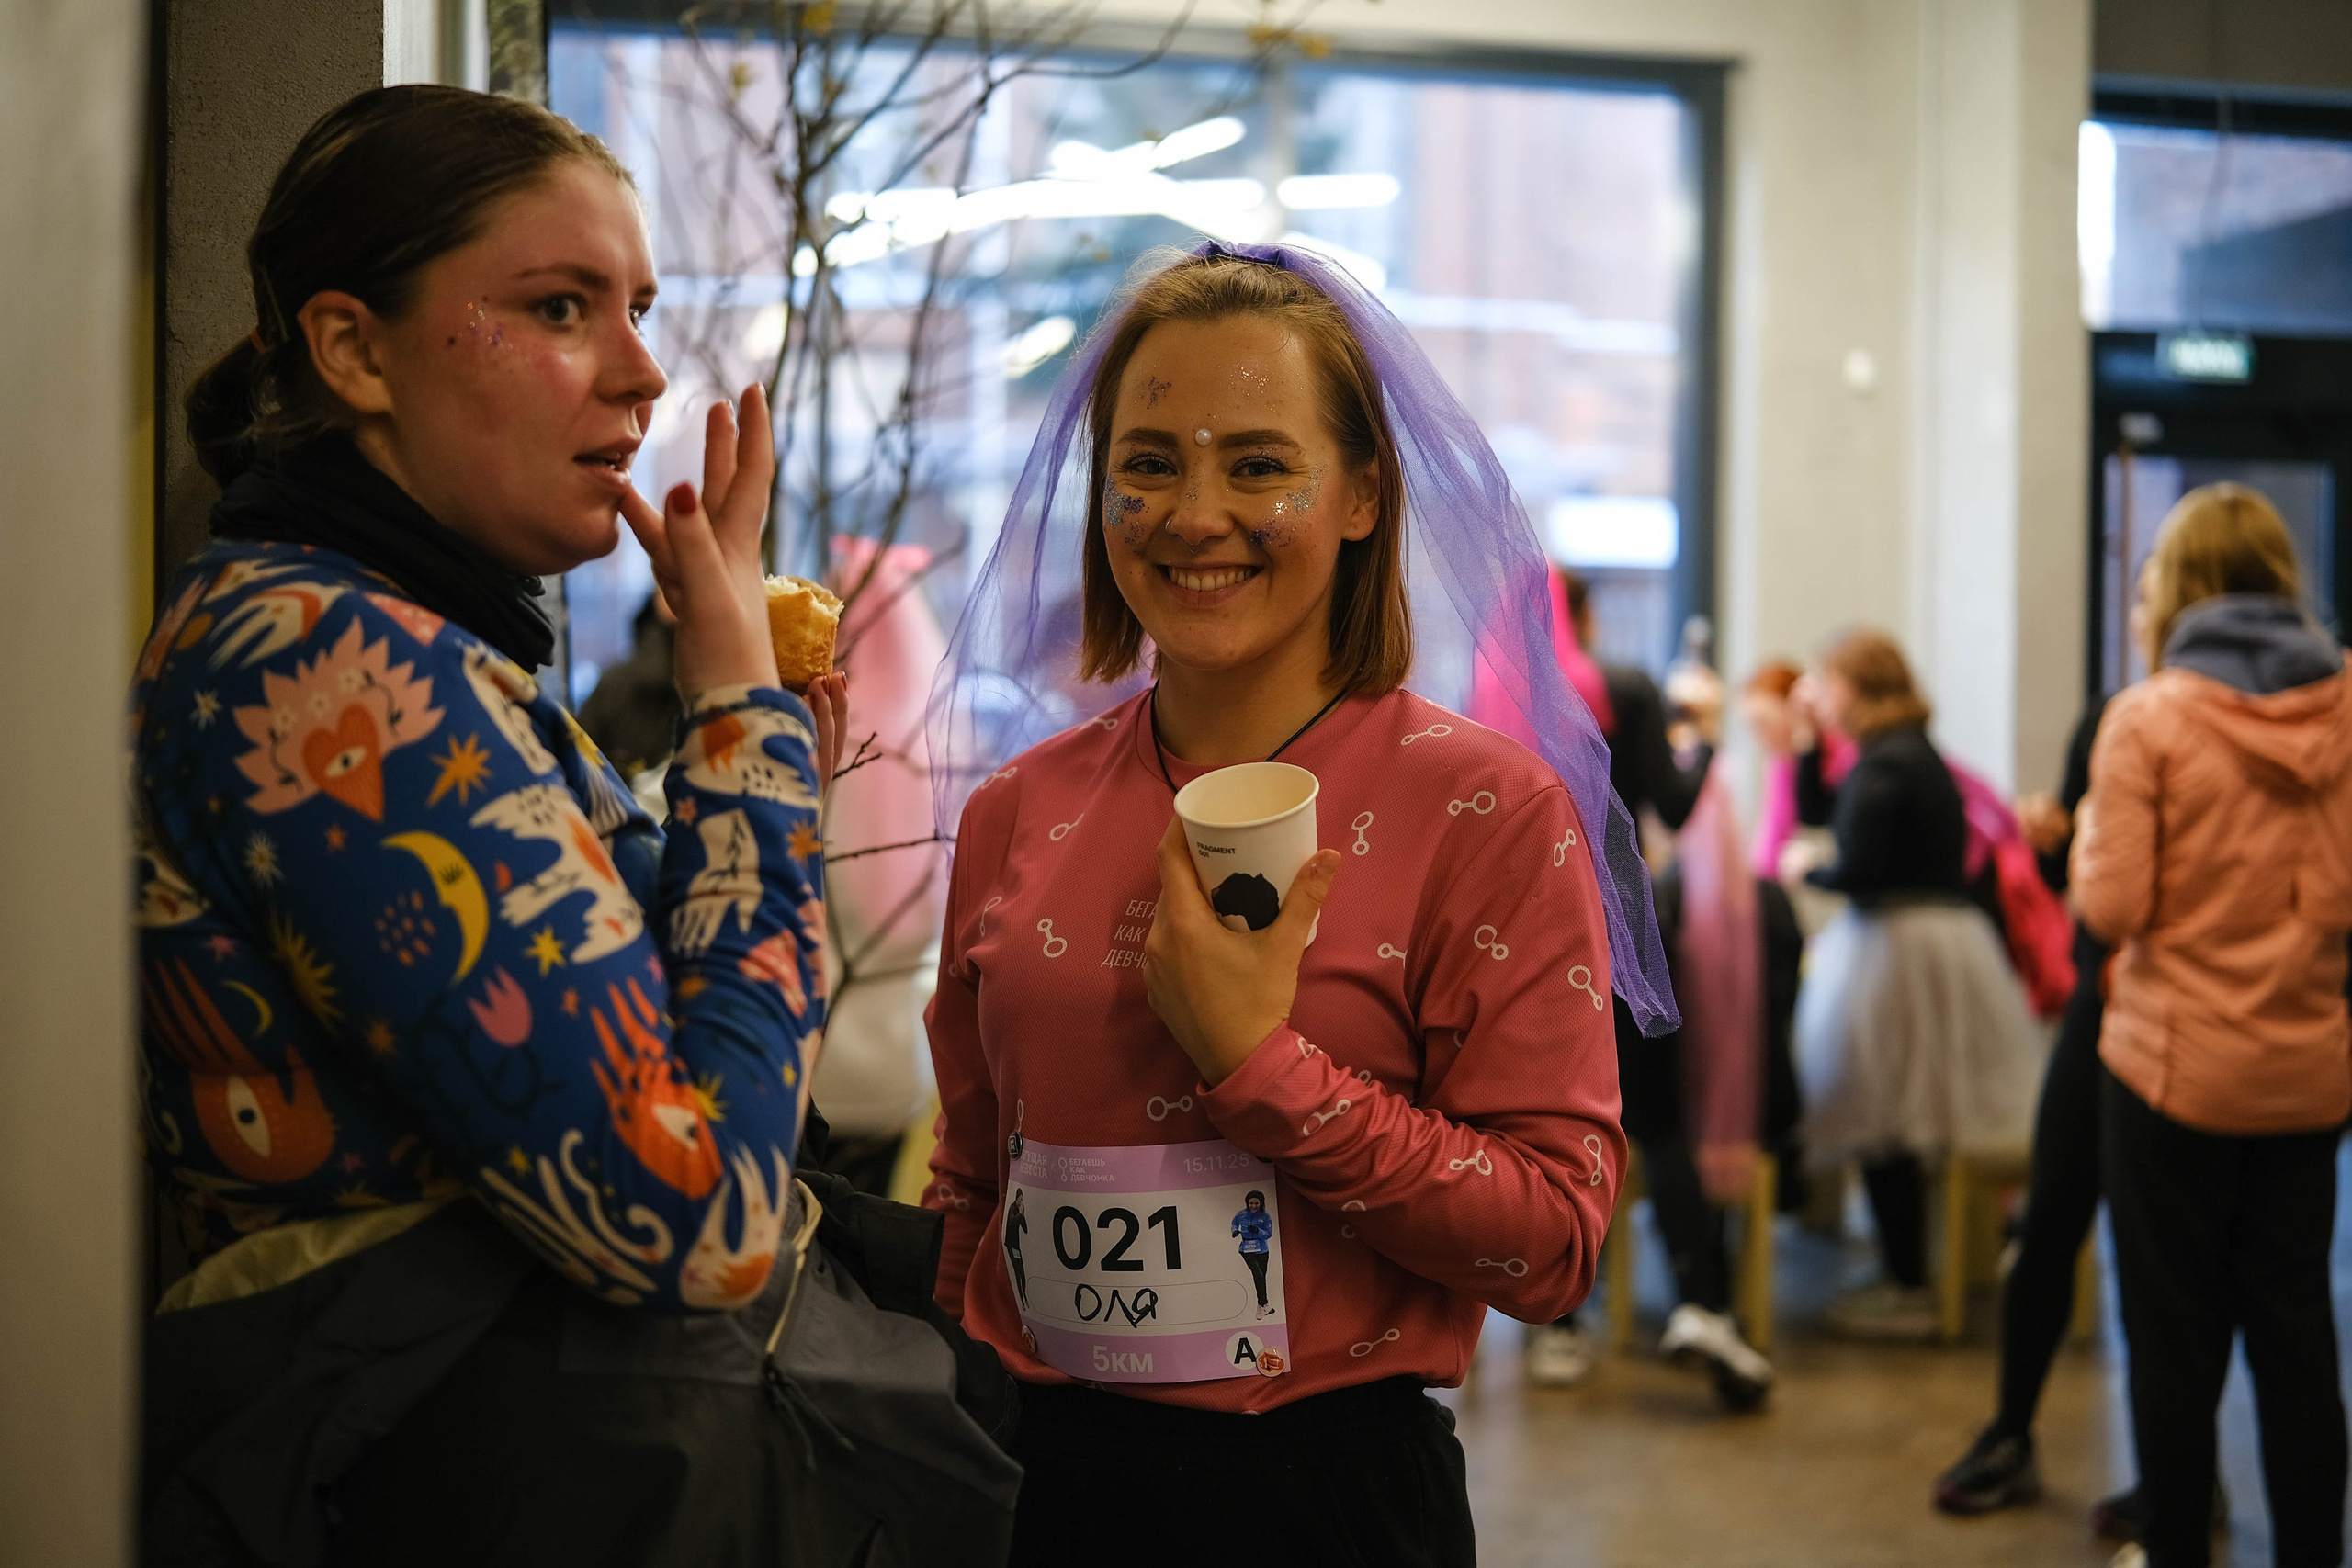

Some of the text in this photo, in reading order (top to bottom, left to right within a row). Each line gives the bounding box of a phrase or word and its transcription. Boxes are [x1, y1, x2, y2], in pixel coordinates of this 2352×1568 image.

[1197, 841, 1236, 854] FRAGMENT
[1114, 924, 1145, 942] КАК
[1069, 1158, 1106, 1167] БЕГАЕШЬ
[1183, 1153, 1250, 1173] 15.11.25
[1052, 1205, 1182, 1271] 021
[1074, 1283, 1159, 1328] ОЛЯ
